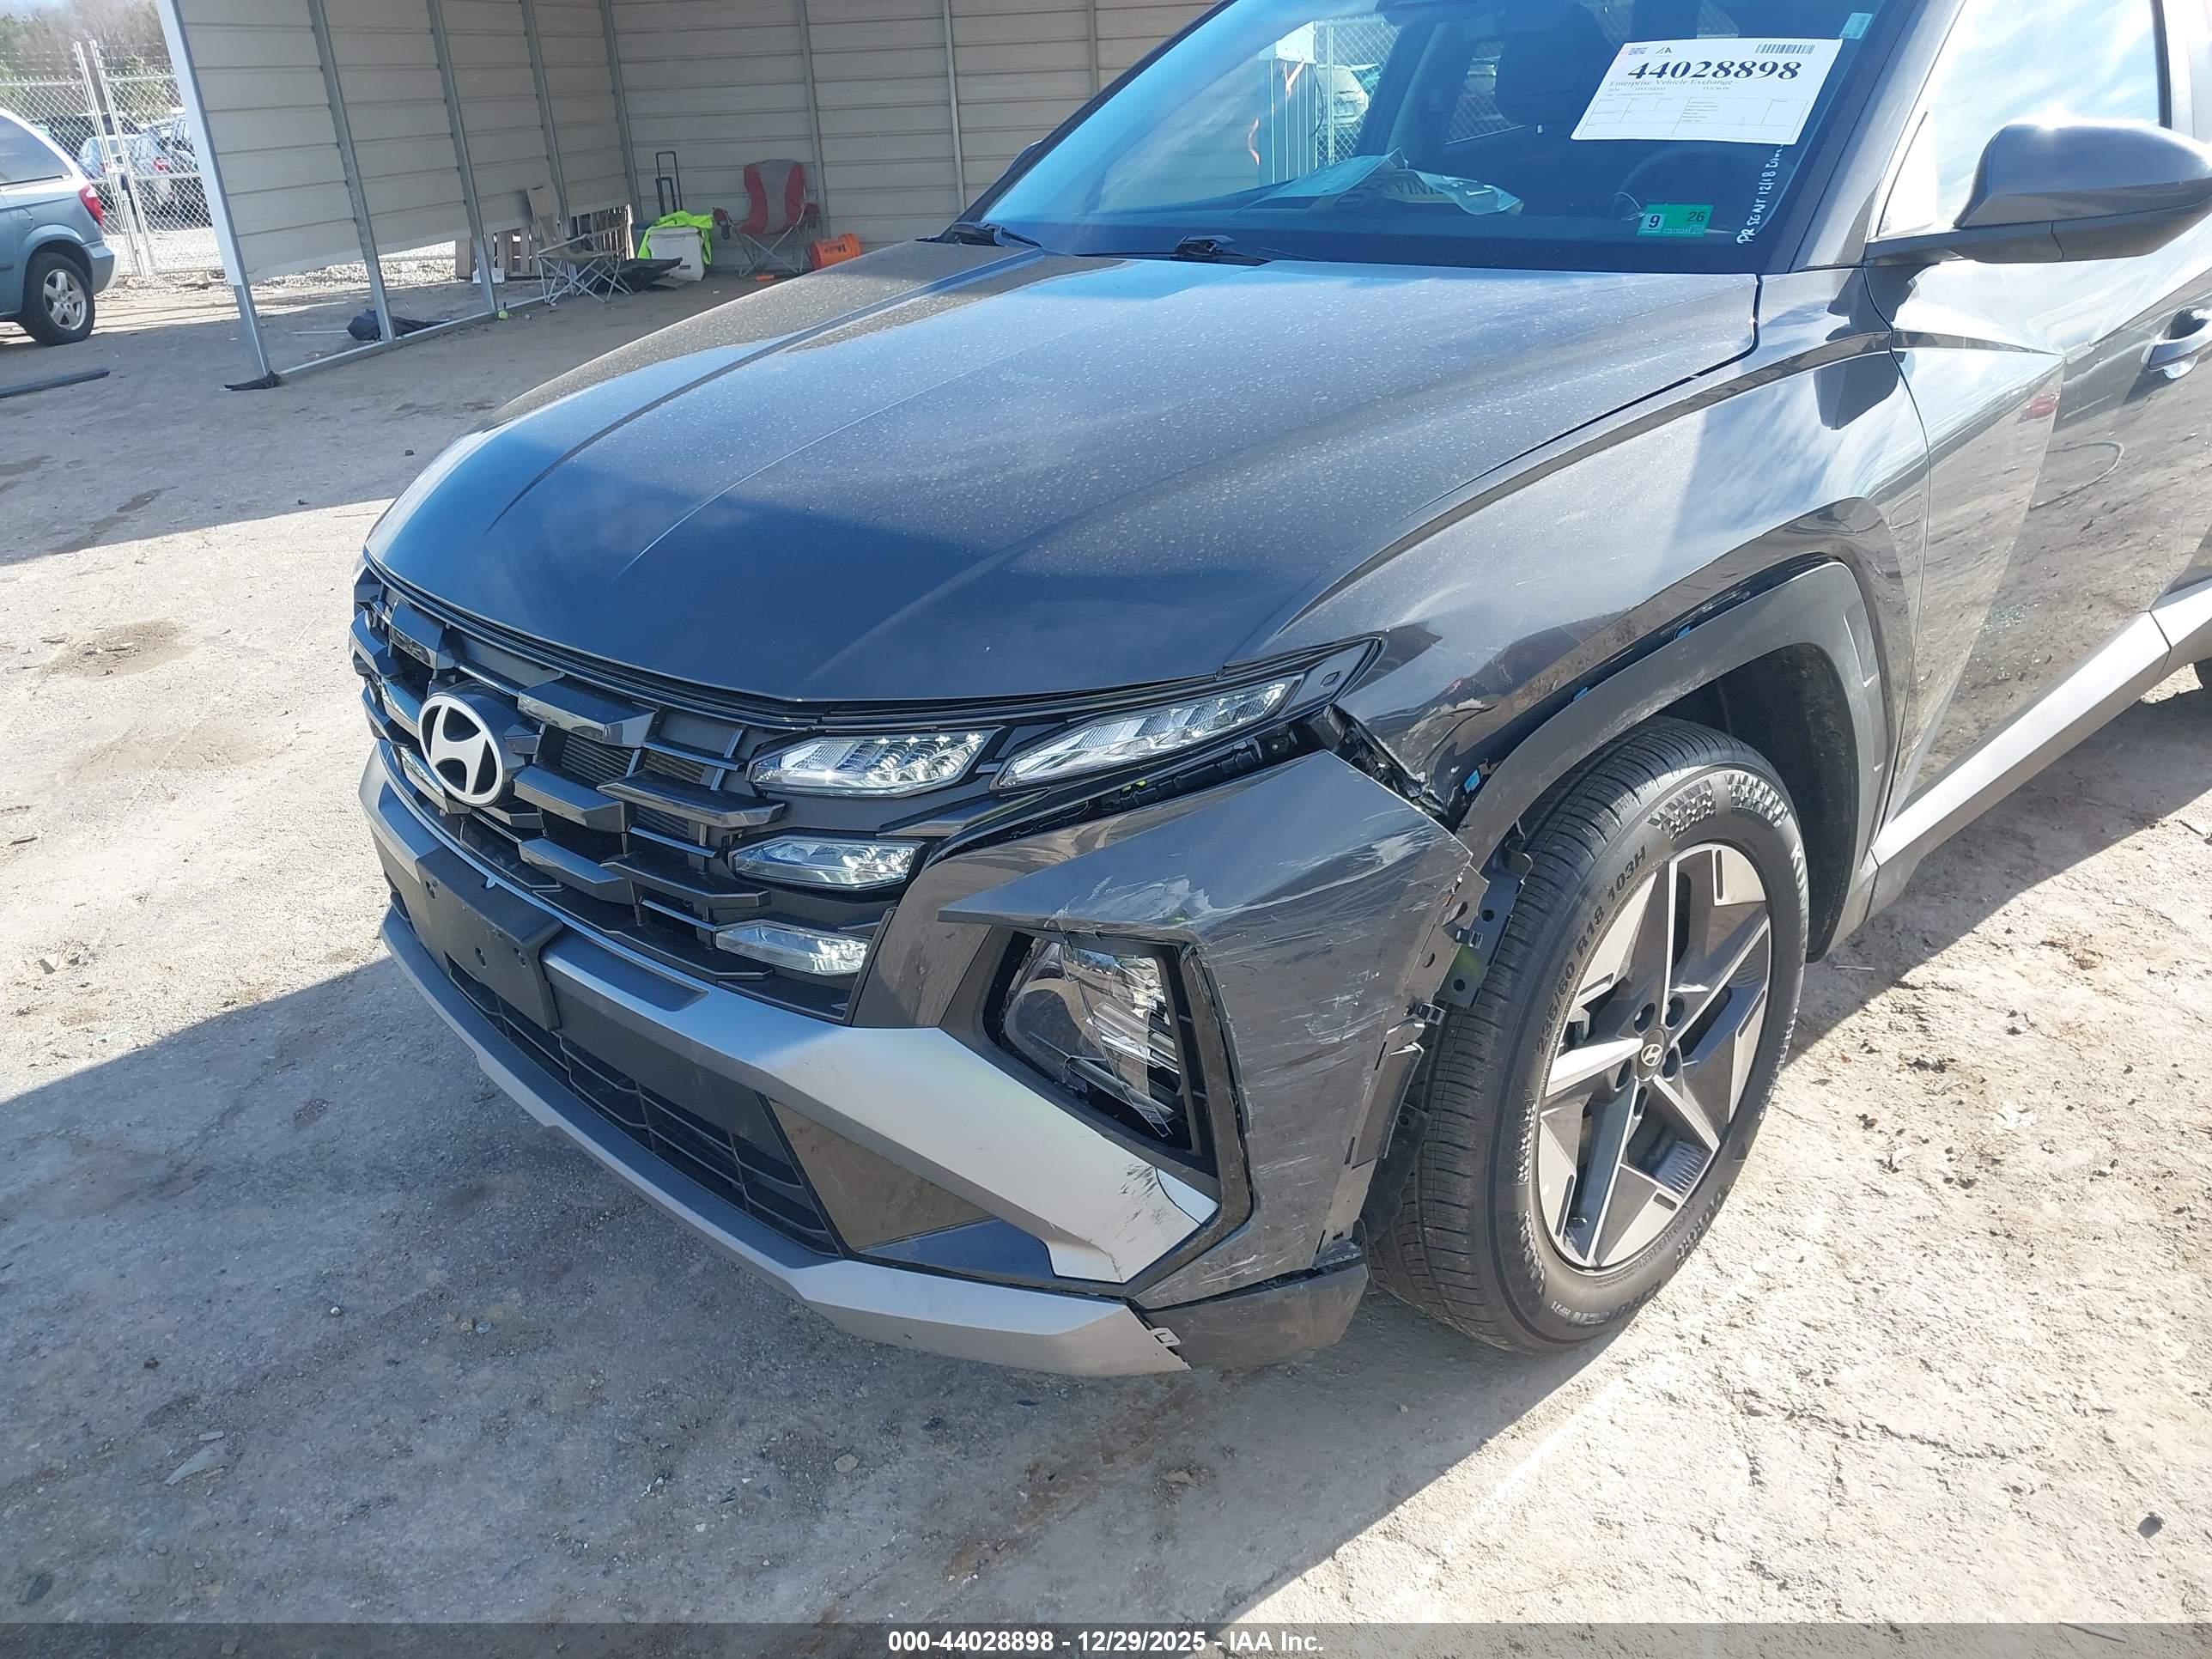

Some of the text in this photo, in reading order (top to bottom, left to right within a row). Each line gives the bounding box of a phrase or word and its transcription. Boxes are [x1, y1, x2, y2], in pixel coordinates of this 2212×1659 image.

[1628, 61, 1802, 79] 44028898
[1649, 211, 1705, 228] 9 26
[1536, 961, 1575, 1056] 235/60
[1575, 905, 1604, 957] R18
[1607, 845, 1647, 902] 103H
